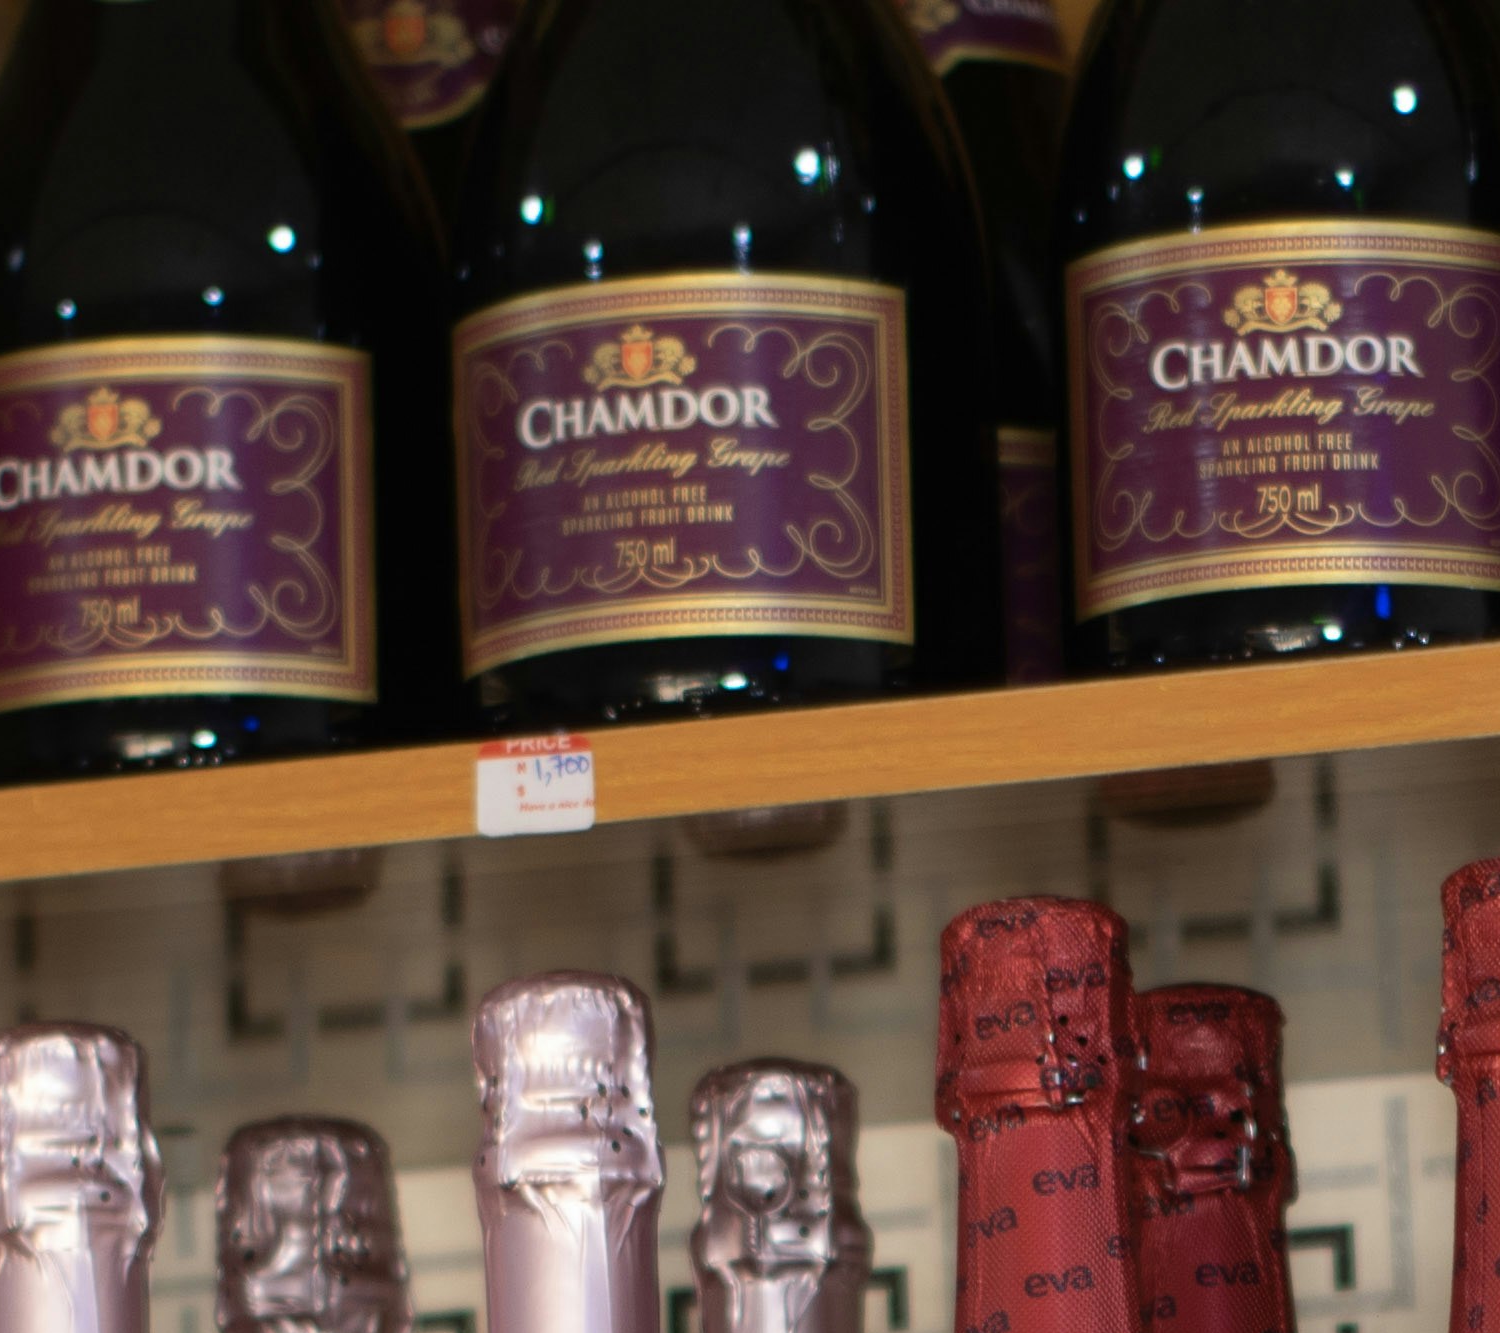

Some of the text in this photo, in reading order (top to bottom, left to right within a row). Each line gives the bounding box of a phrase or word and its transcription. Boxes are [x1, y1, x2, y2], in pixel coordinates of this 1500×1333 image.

[1151, 334, 1425, 391] CHAMDOR
[517, 387, 779, 450] CHAMDOR
[514, 438, 791, 492] Red Sparkling Grape
[562, 505, 735, 536] SPARKLING FRUIT DRINK
[615, 538, 675, 567] 750 ml
[81, 597, 140, 628] 750 ml
[535, 754, 590, 787] 1,700
